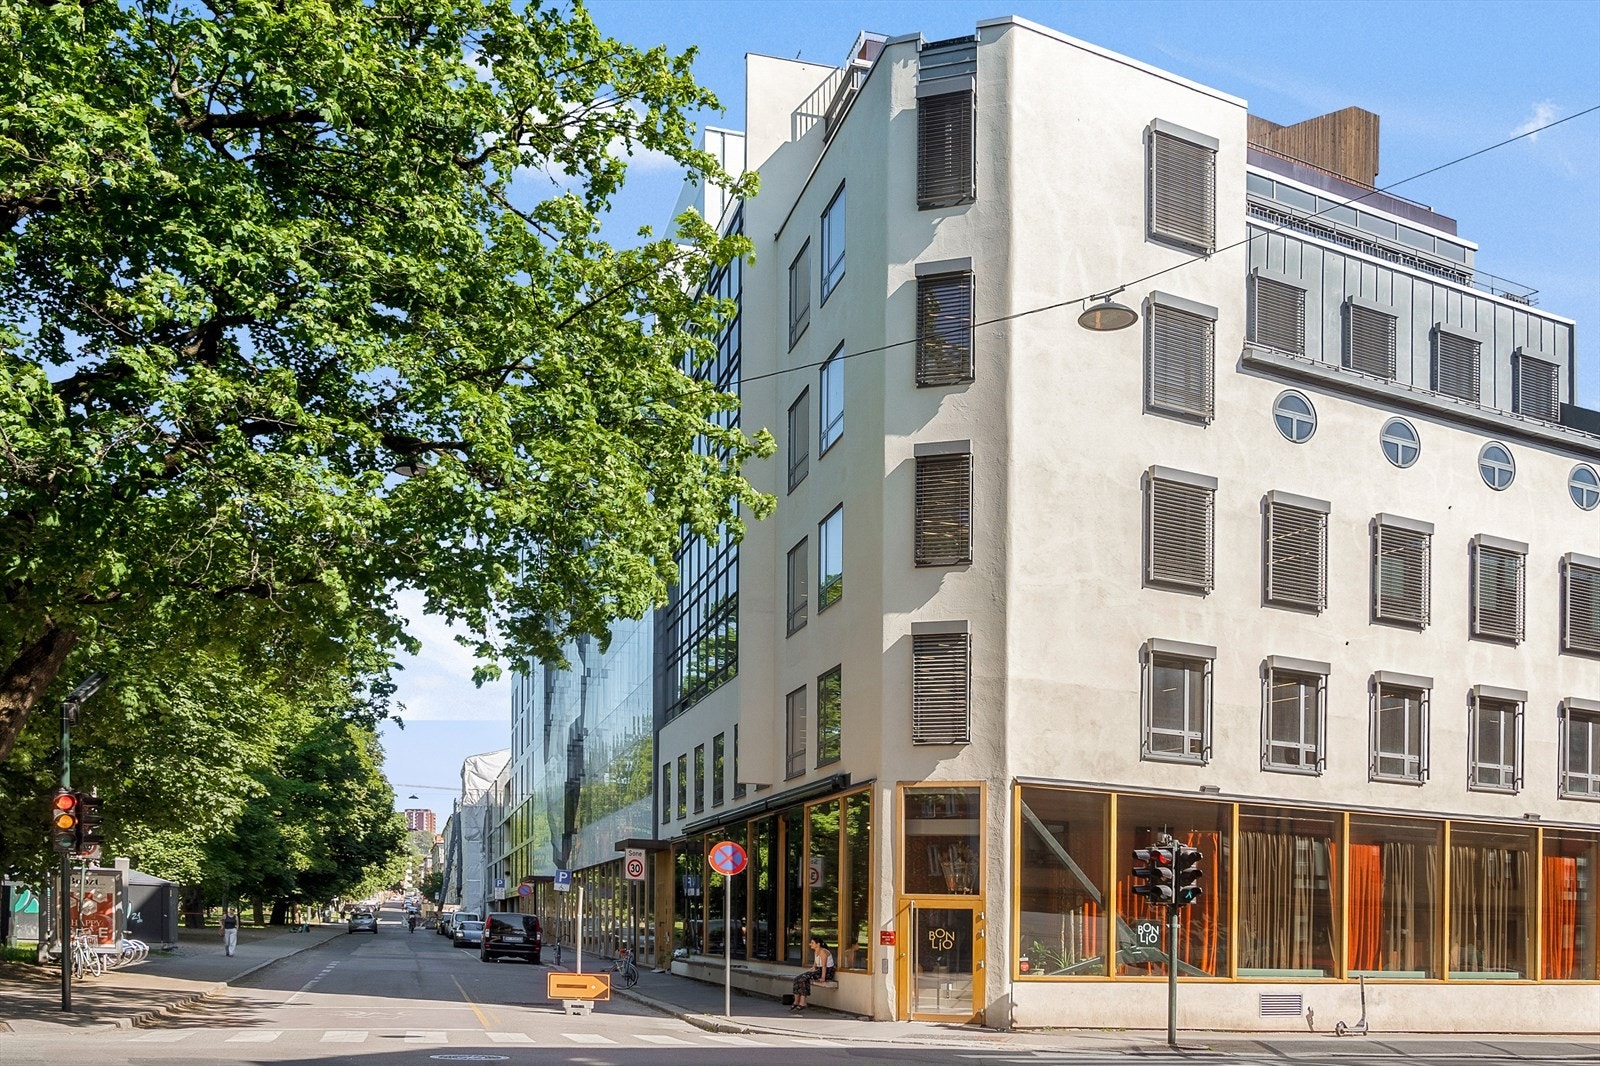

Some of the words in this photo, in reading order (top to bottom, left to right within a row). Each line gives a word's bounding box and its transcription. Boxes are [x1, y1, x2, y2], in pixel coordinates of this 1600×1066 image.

[630, 863, 641, 873] 30
[558, 871, 568, 882] P
[496, 879, 503, 887] P
[1137, 922, 1160, 935] BON
[928, 928, 955, 941] BON
